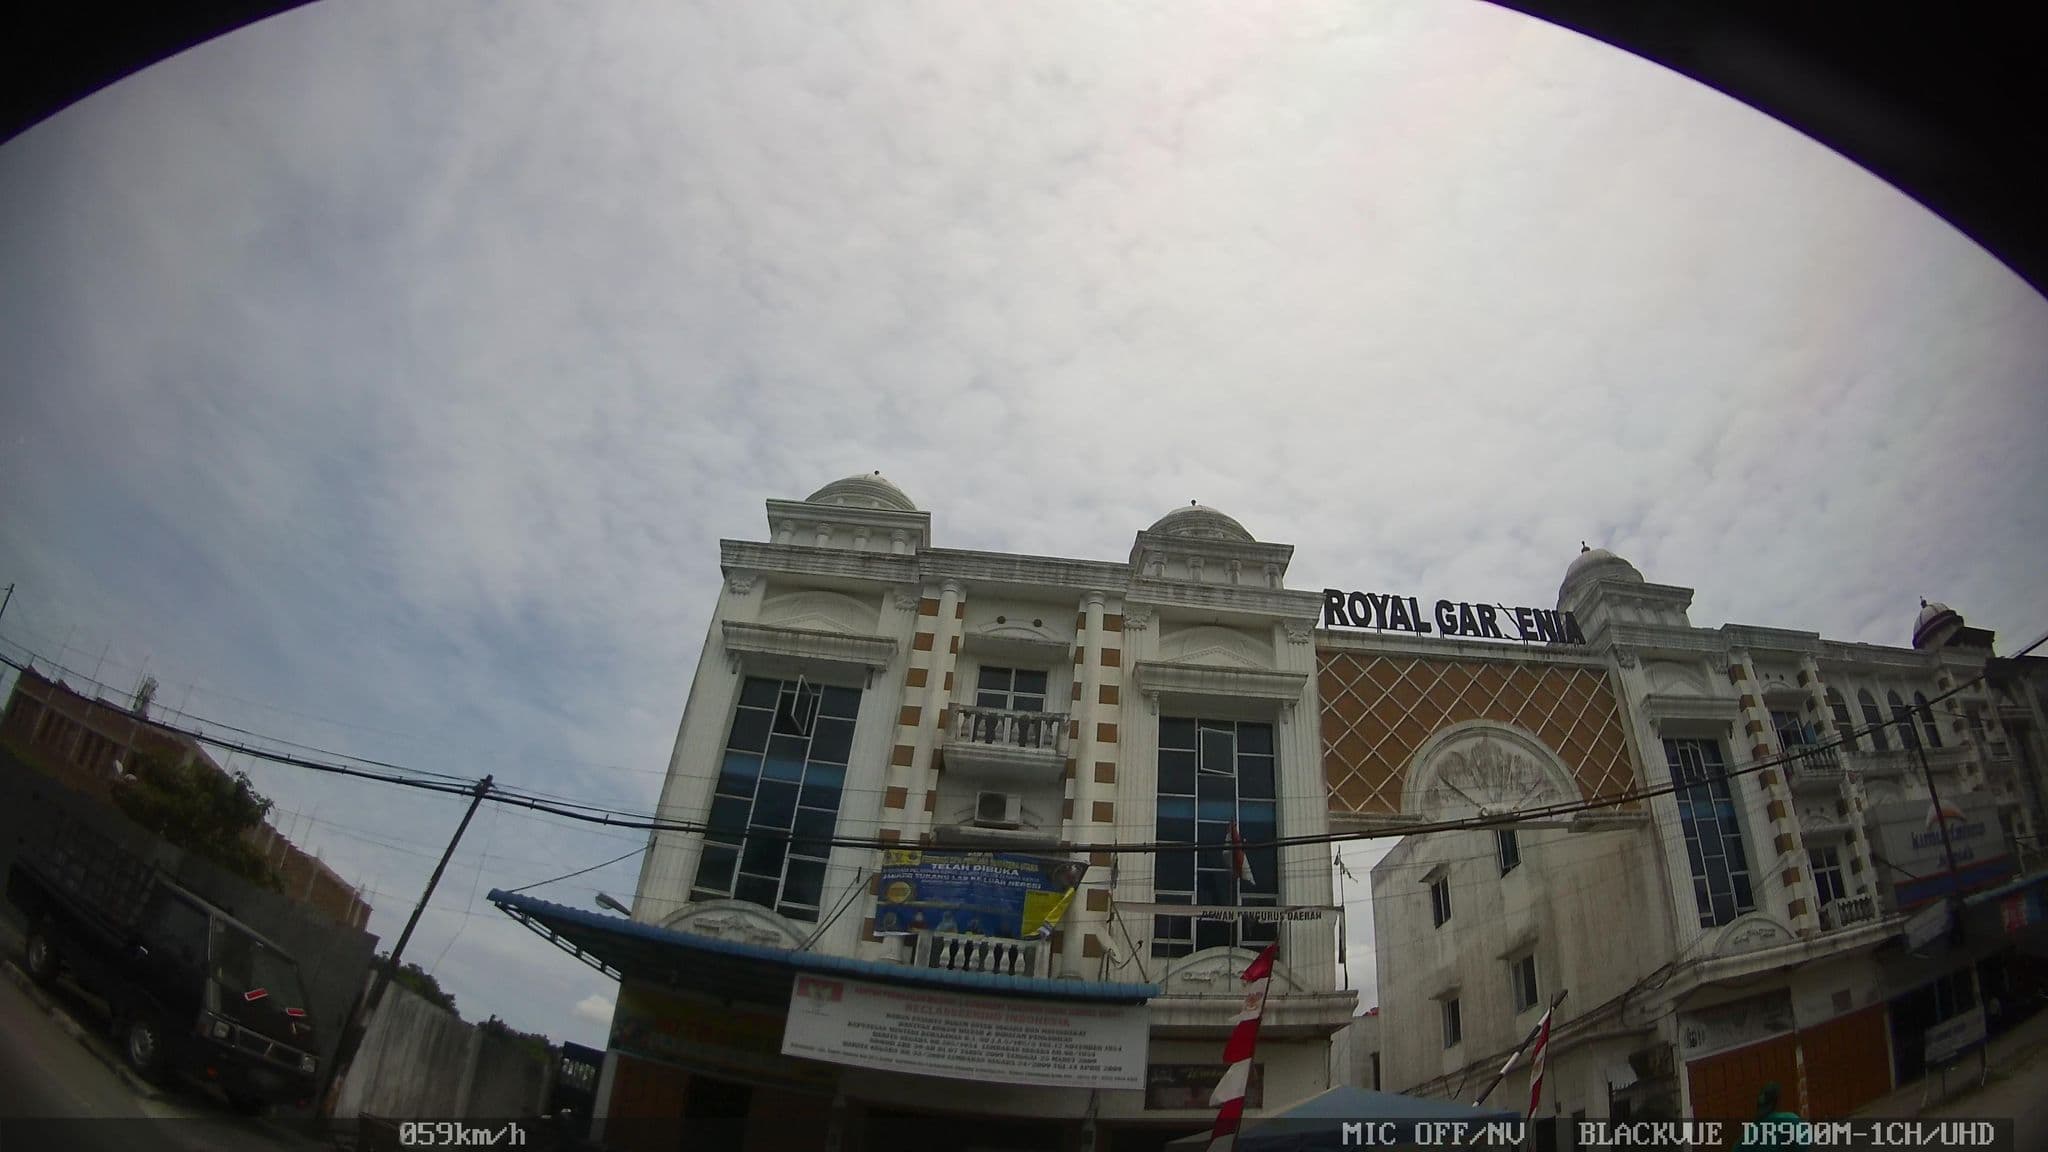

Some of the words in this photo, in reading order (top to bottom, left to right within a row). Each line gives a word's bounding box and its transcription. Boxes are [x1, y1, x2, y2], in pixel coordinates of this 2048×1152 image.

[1323, 589, 1432, 633] ROYAL
[1435, 599, 1586, 644] GARENIA
[931, 863, 970, 872] TELAH
[973, 864, 1020, 877] DIBUKA
